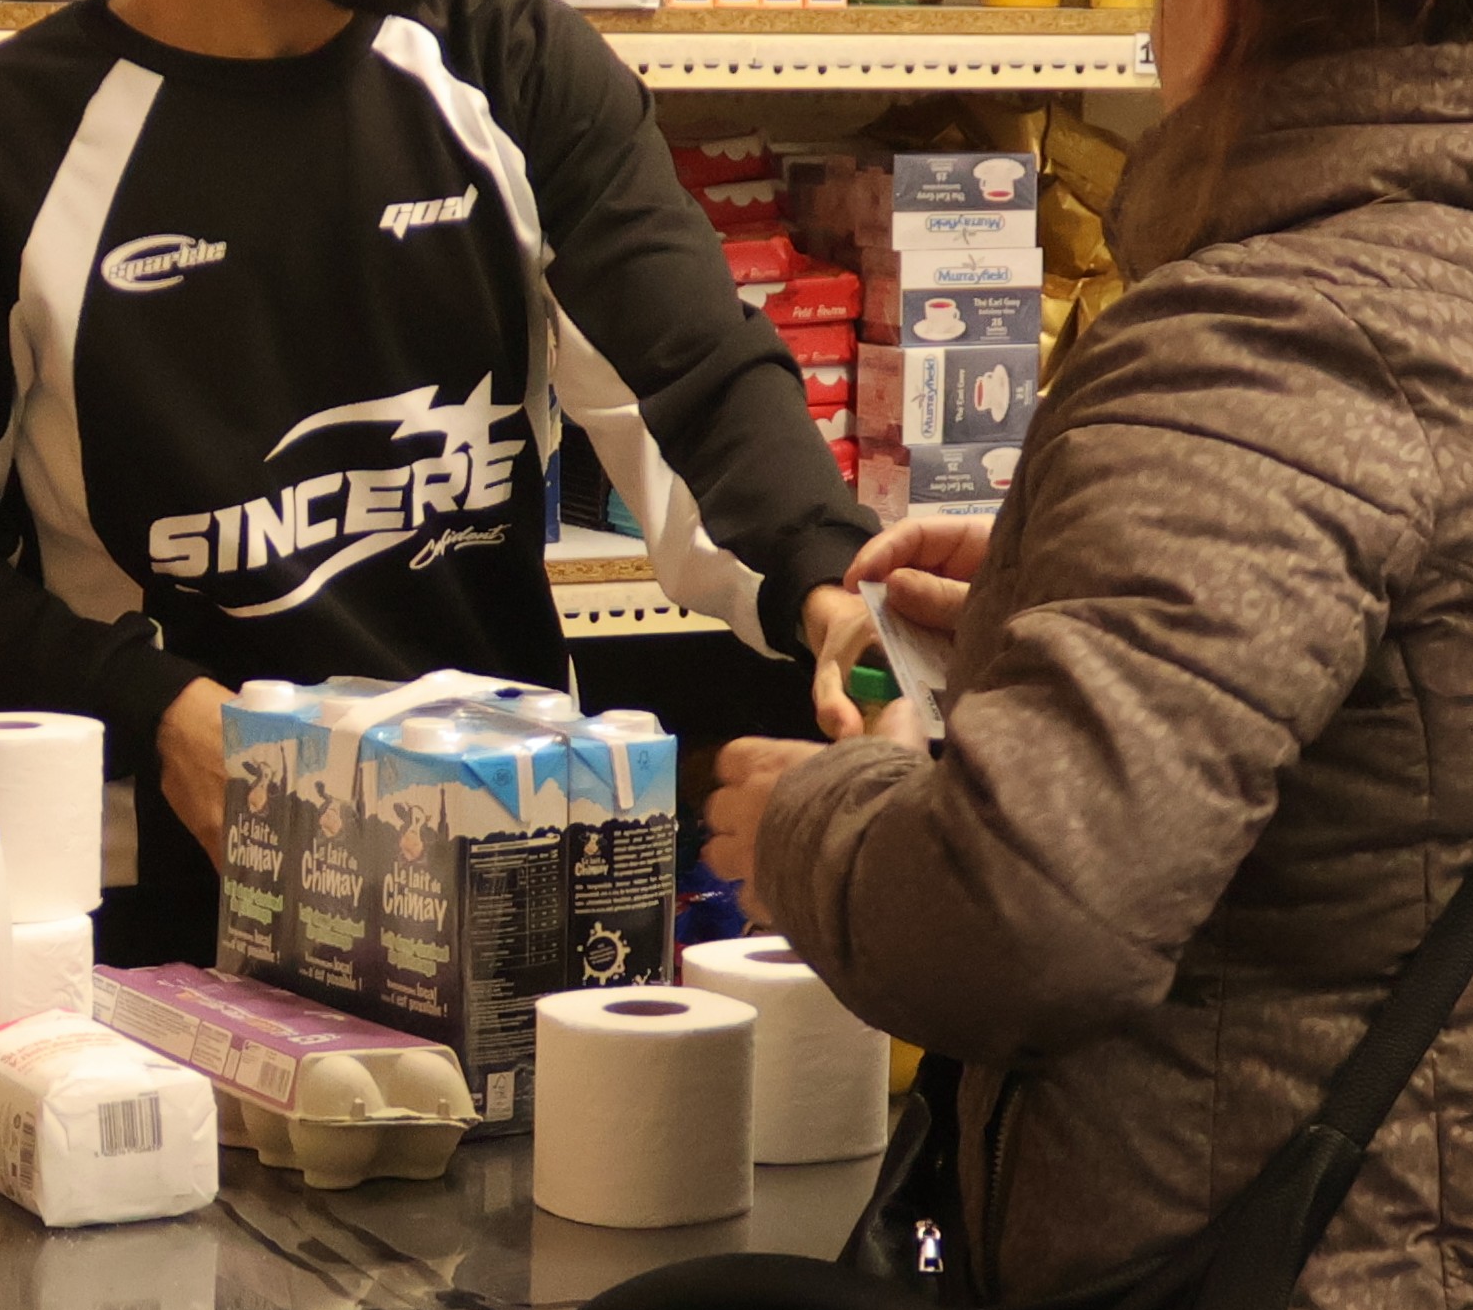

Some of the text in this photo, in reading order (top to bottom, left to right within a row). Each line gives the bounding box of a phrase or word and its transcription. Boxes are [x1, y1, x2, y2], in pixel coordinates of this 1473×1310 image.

[1139, 40, 1154, 64] 1
[378, 183, 479, 240] goal
[929, 214, 1002, 231] Murrayfield
[938, 268, 1009, 284] Murrayfield
[923, 358, 938, 434] Murrayfield
[149, 439, 527, 579] SINCERE
[251, 817, 269, 841] lait
[228, 825, 283, 882] Chimay
[313, 838, 325, 862] Le
[328, 842, 347, 867] lait
[301, 849, 363, 908] Chimay
[394, 861, 407, 885] Le
[409, 866, 430, 890] lait
[383, 873, 448, 932] Chimay
